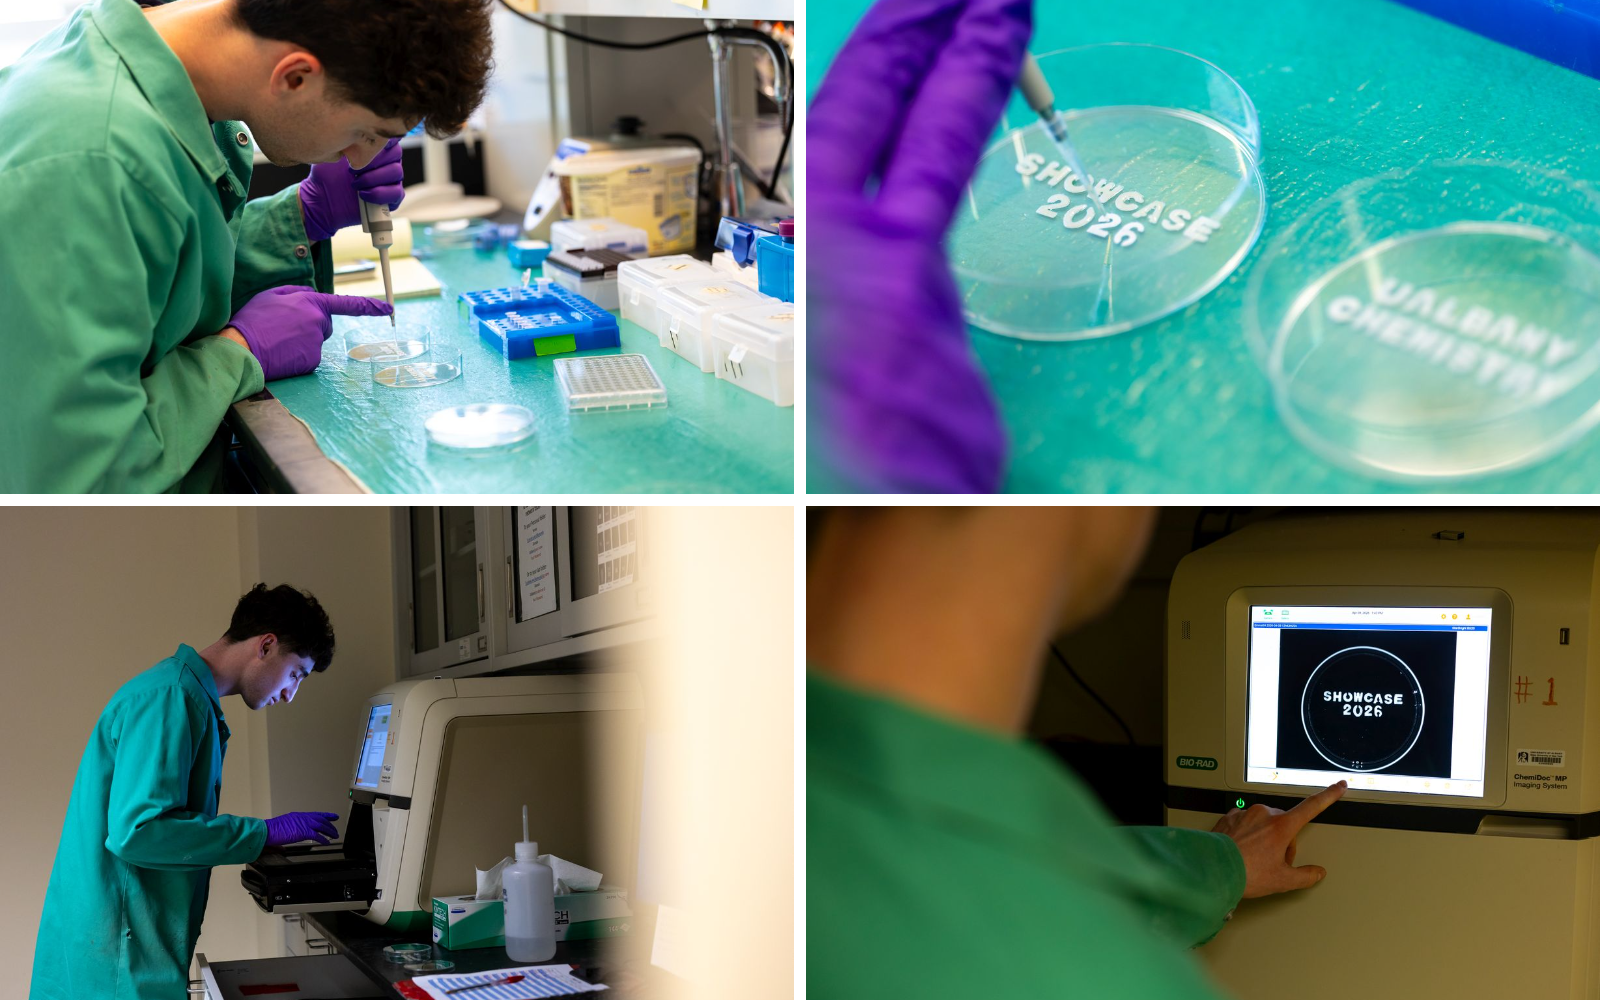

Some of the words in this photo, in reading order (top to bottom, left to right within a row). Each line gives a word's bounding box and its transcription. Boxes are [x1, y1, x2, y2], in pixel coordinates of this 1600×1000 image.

[1014, 152, 1222, 244] SHOWCASE
[1035, 193, 1146, 248] 2026
[1376, 277, 1578, 367] UALBANY
[1323, 690, 1404, 705] SHOWCASE
[1342, 703, 1383, 718] 2026
[1513, 781, 1541, 790] Imaging
[1542, 782, 1568, 790] System
